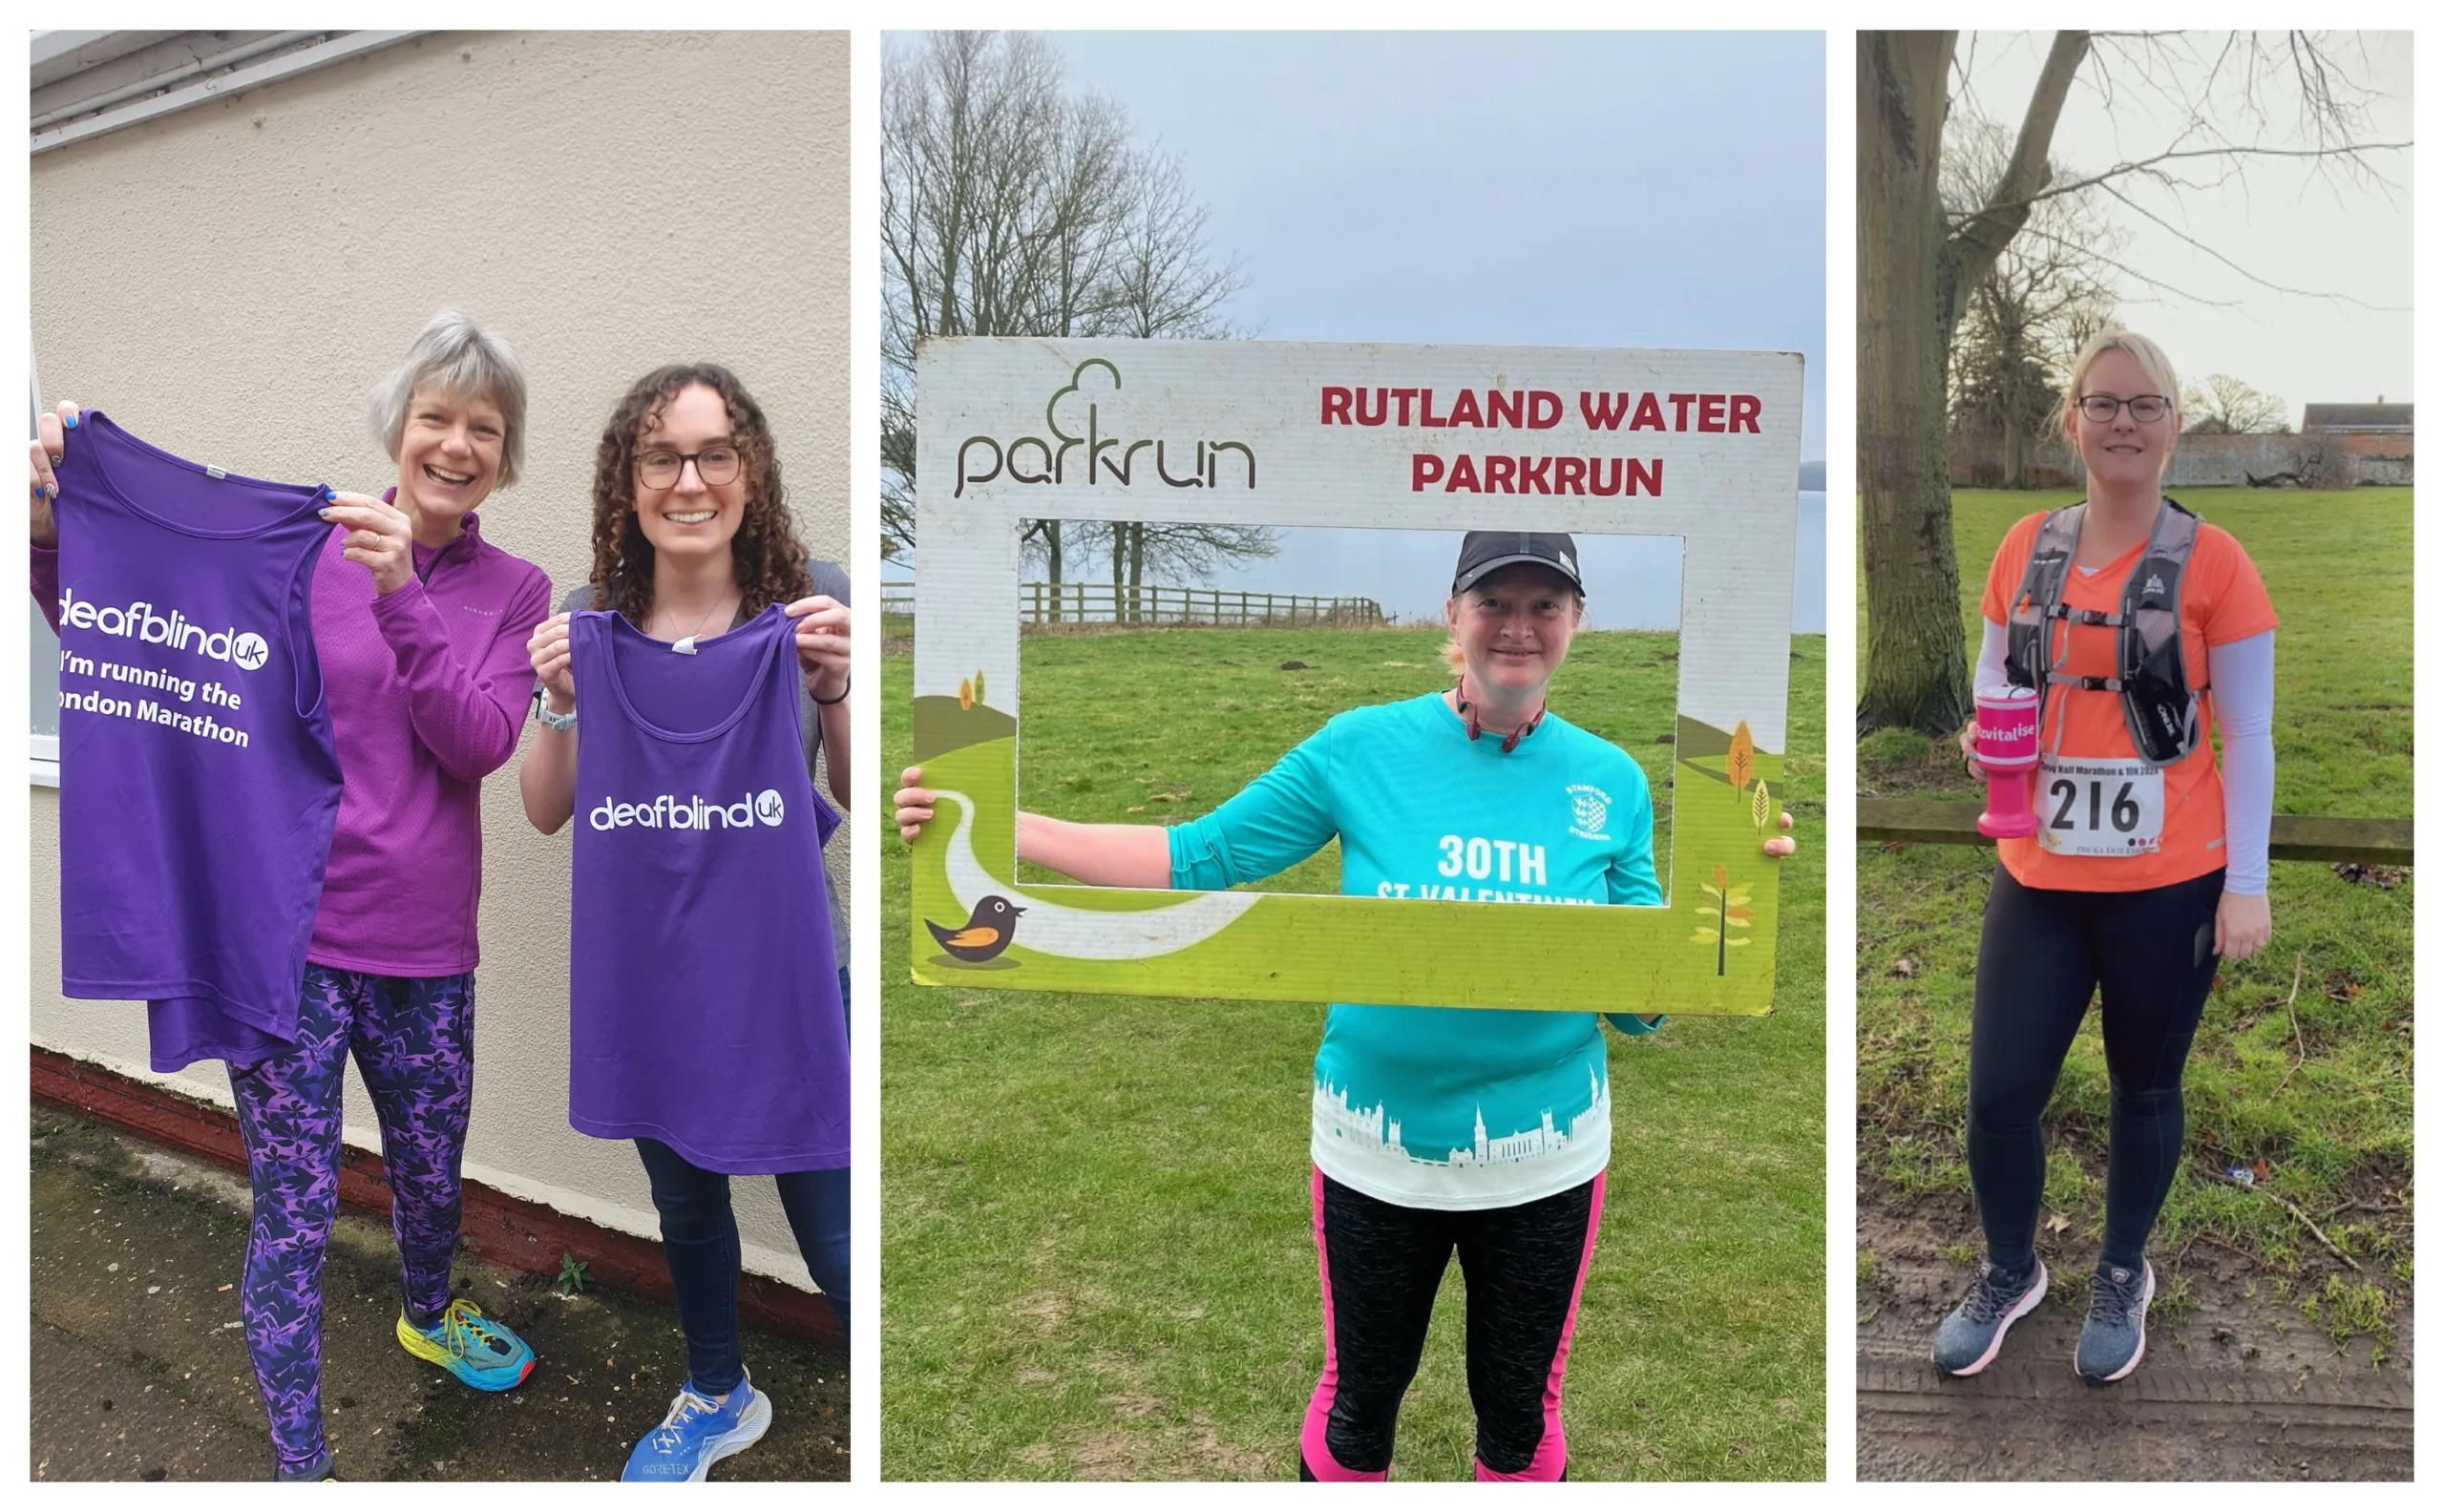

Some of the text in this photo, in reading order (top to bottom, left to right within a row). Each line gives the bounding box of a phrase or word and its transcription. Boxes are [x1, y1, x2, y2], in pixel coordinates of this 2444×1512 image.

[1320, 387, 1762, 434] RUTLAND WATER
[955, 402, 1255, 498] parkrun
[1411, 453, 1663, 497] PARKRUN
[235, 640, 265, 665] uk
[100, 661, 197, 703] running
[201, 682, 242, 710] the
[58, 690, 250, 748] ndon Marathon
[2057, 765, 2075, 774] Half
[2075, 766, 2117, 776] Marathon
[589, 790, 783, 831] deafblind uk
[1566, 784, 1612, 805] STAMFORD
[2050, 779, 2140, 832] 216
[1438, 834, 1547, 886] 30TH
